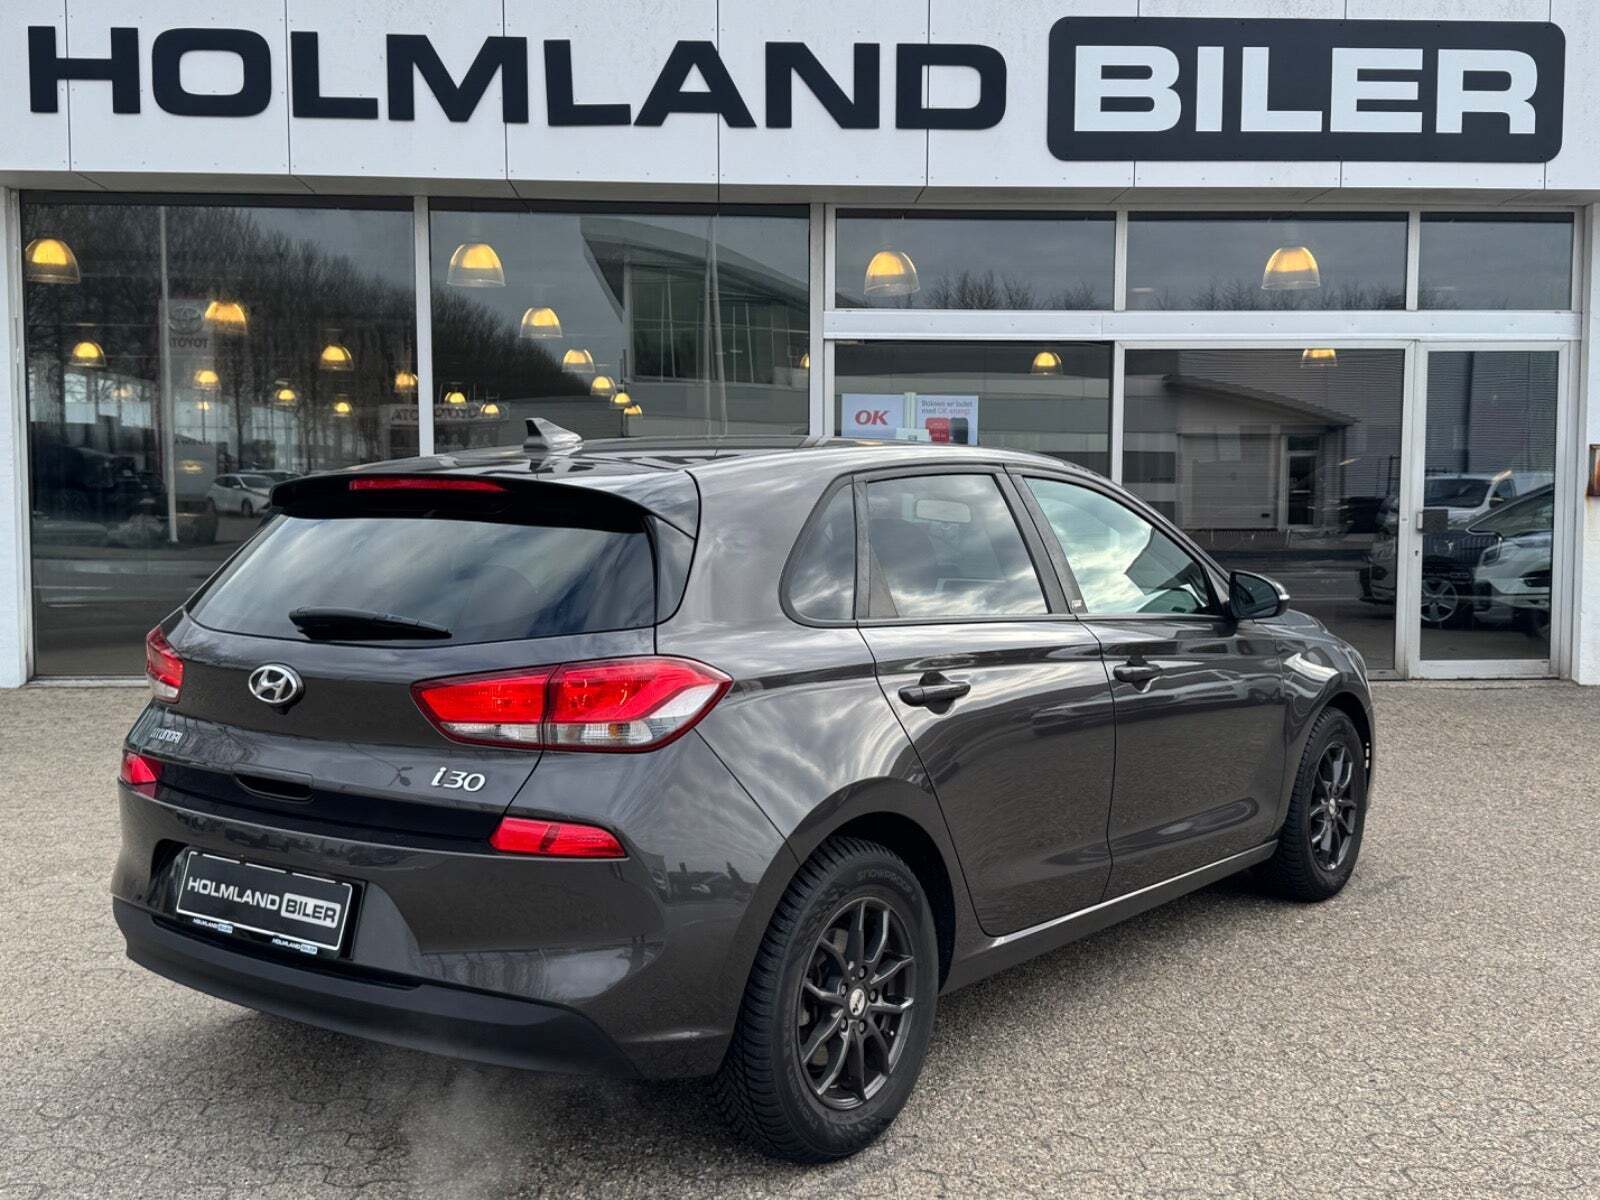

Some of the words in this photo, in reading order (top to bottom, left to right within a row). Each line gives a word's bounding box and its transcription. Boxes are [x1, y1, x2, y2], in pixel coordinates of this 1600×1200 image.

[28, 26, 1007, 130] HOLMLAND
[1074, 45, 1538, 135] BILER
[854, 410, 889, 426] OK
[431, 766, 486, 792] i30
[187, 876, 280, 911] HOLMLAND
[284, 896, 338, 923] BILER
